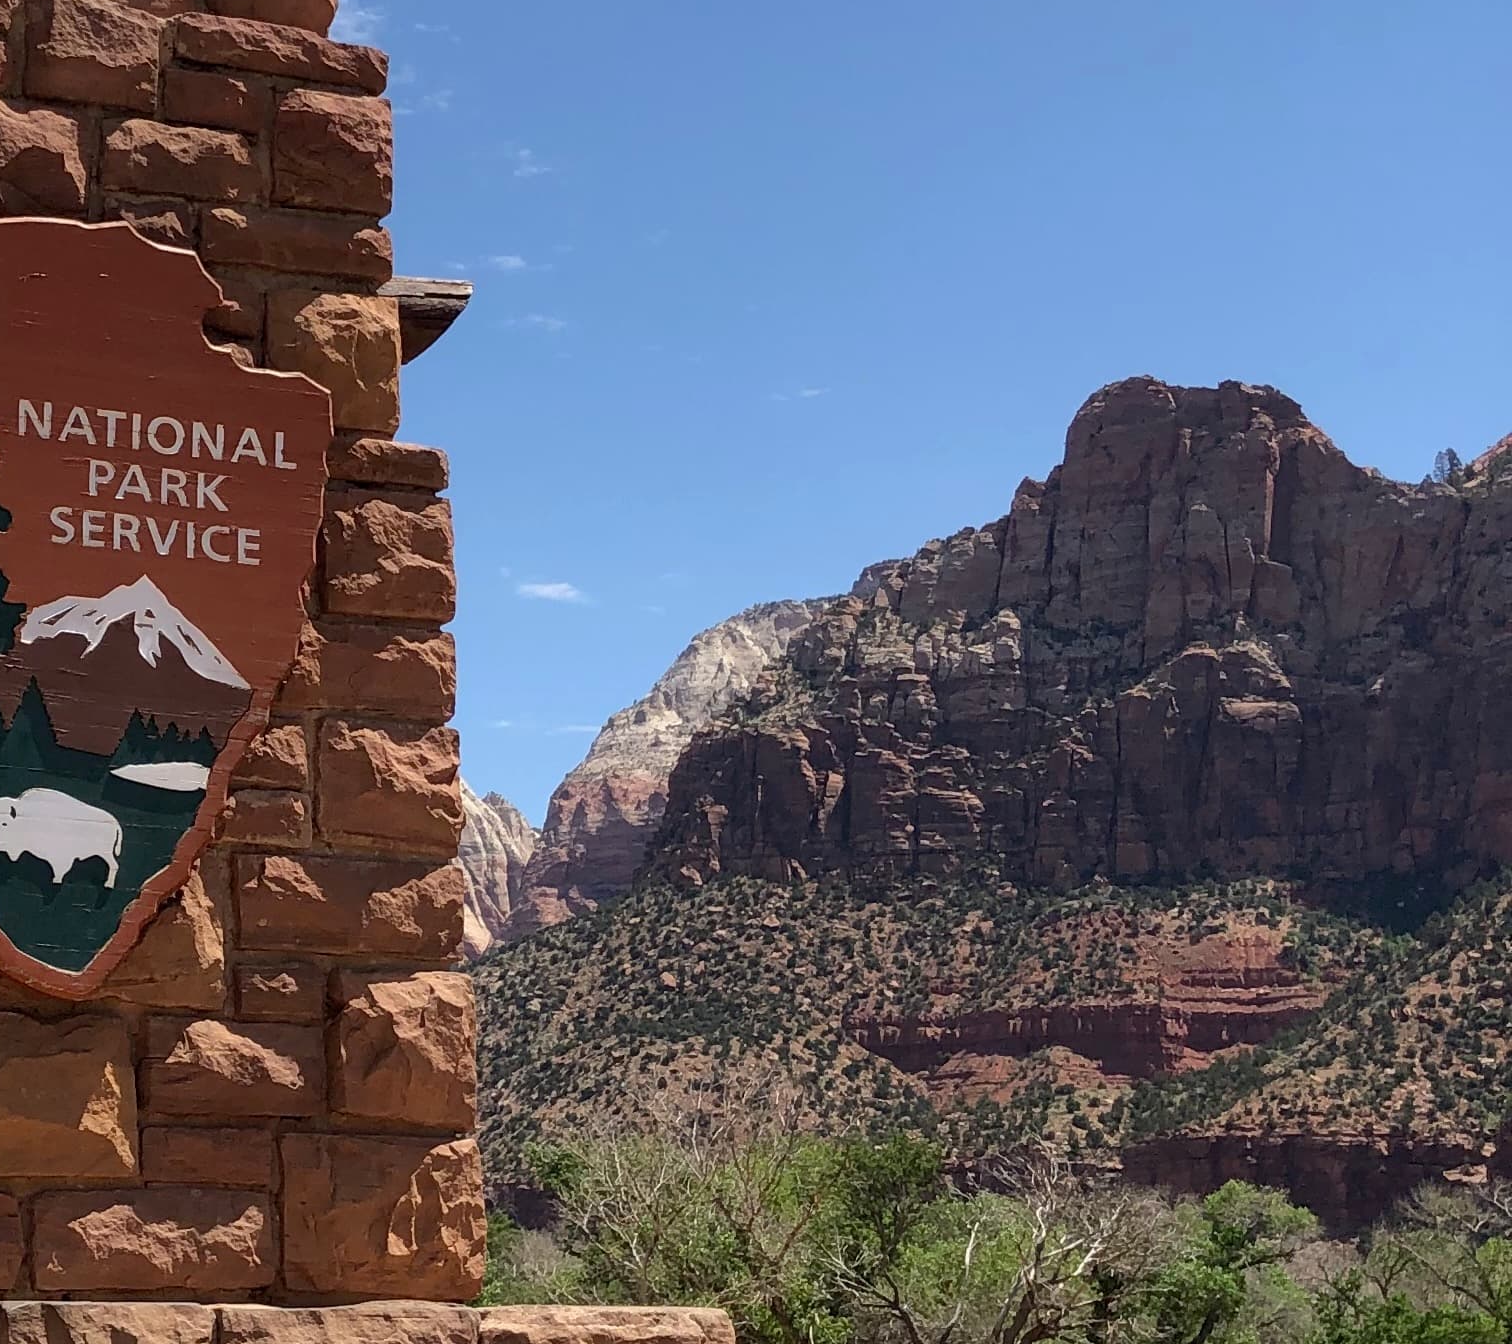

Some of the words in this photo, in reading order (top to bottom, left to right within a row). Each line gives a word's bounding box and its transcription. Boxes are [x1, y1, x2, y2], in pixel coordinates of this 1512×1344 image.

[18, 399, 297, 469] NATIONAL
[88, 459, 228, 511] PARK
[50, 506, 261, 565] SERVICE
